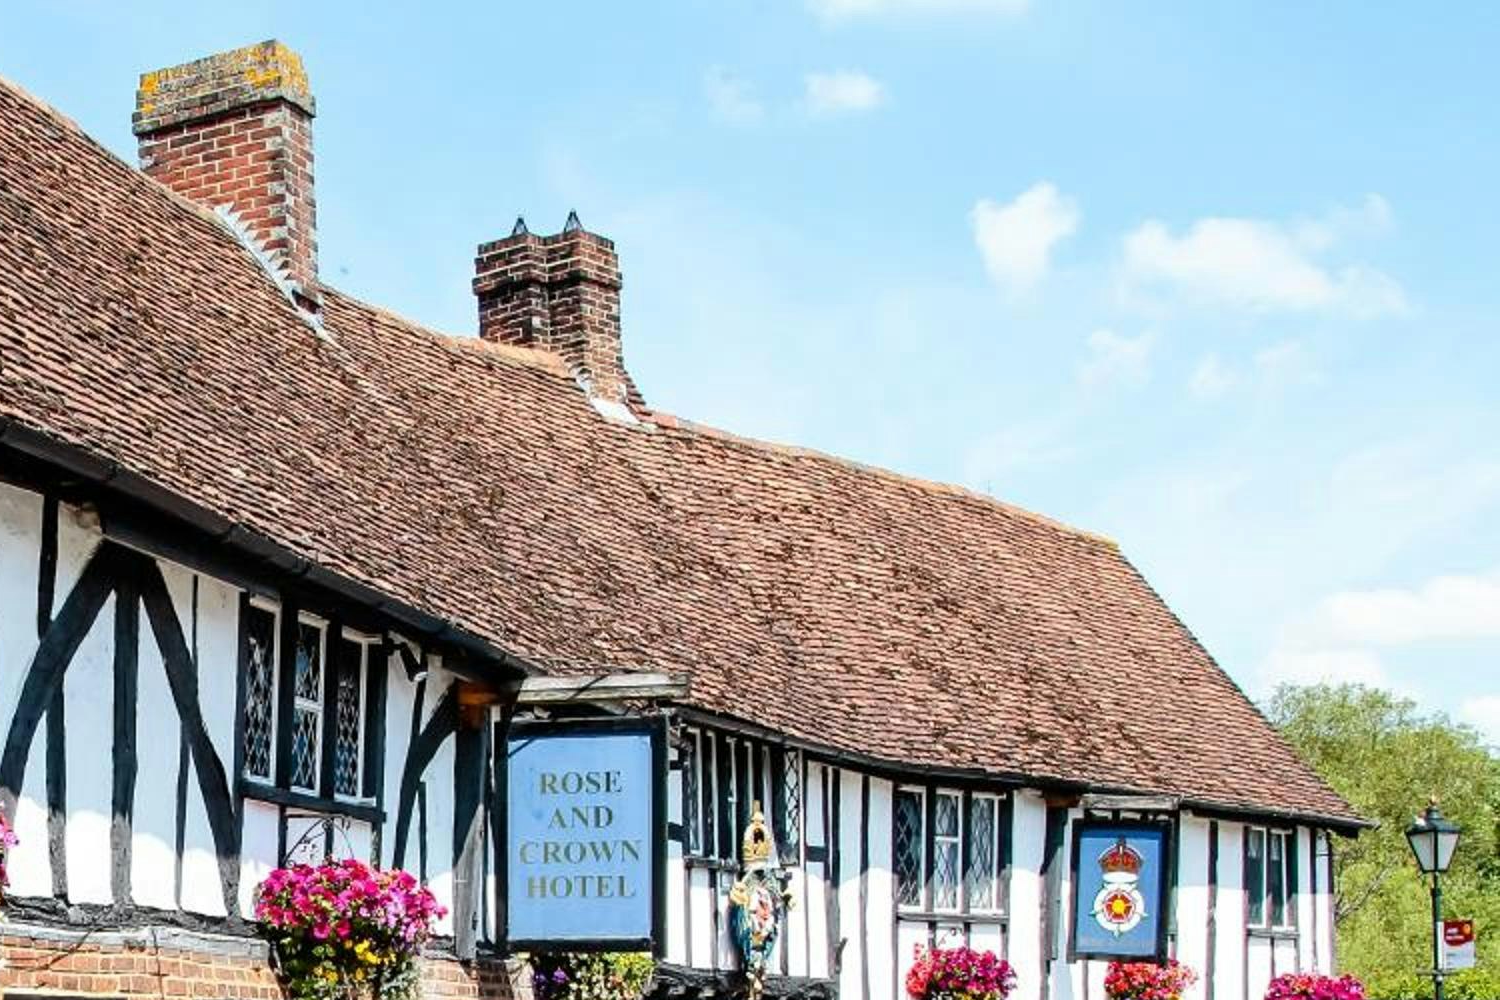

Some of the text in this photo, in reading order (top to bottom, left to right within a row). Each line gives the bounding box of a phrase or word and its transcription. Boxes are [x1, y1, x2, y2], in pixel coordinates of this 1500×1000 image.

[540, 770, 622, 795] ROSE
[548, 805, 614, 829] AND
[519, 839, 643, 864] CROWN
[527, 874, 636, 898] HOTEL
